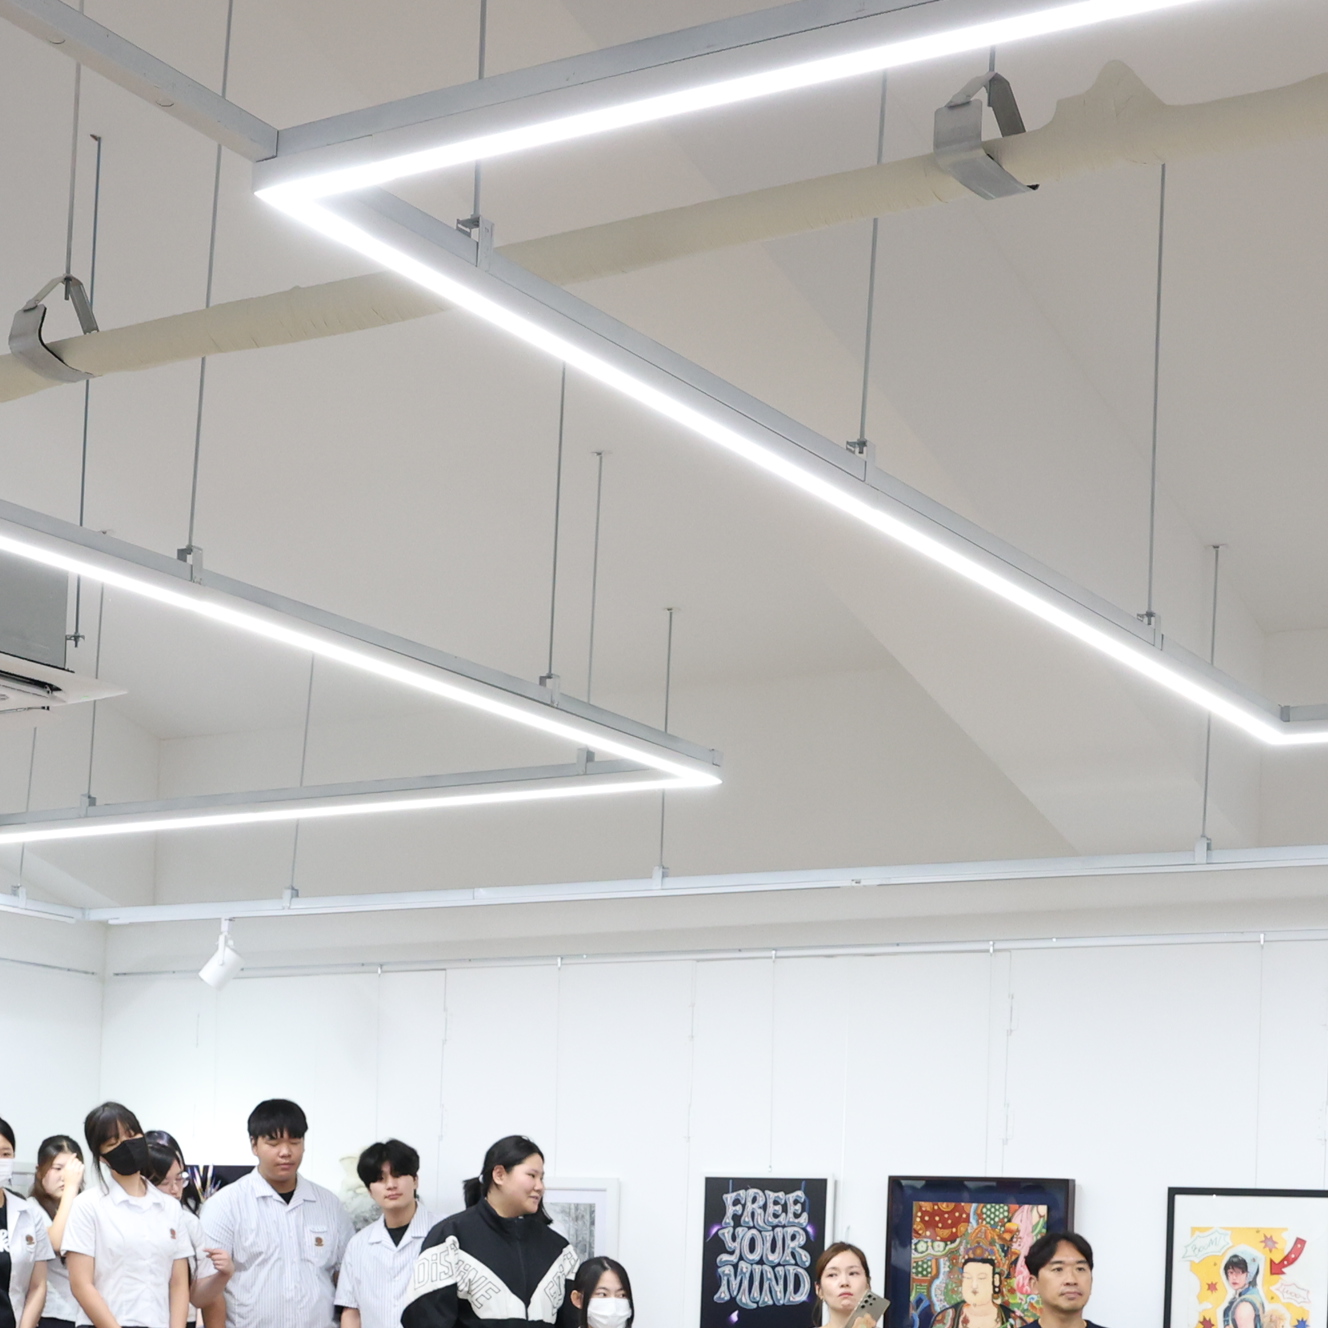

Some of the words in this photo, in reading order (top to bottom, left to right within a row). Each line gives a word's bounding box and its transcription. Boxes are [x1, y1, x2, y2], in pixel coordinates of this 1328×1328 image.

[722, 1188, 808, 1230] FREE
[716, 1226, 811, 1268] YOUR
[713, 1261, 811, 1309] MIND
